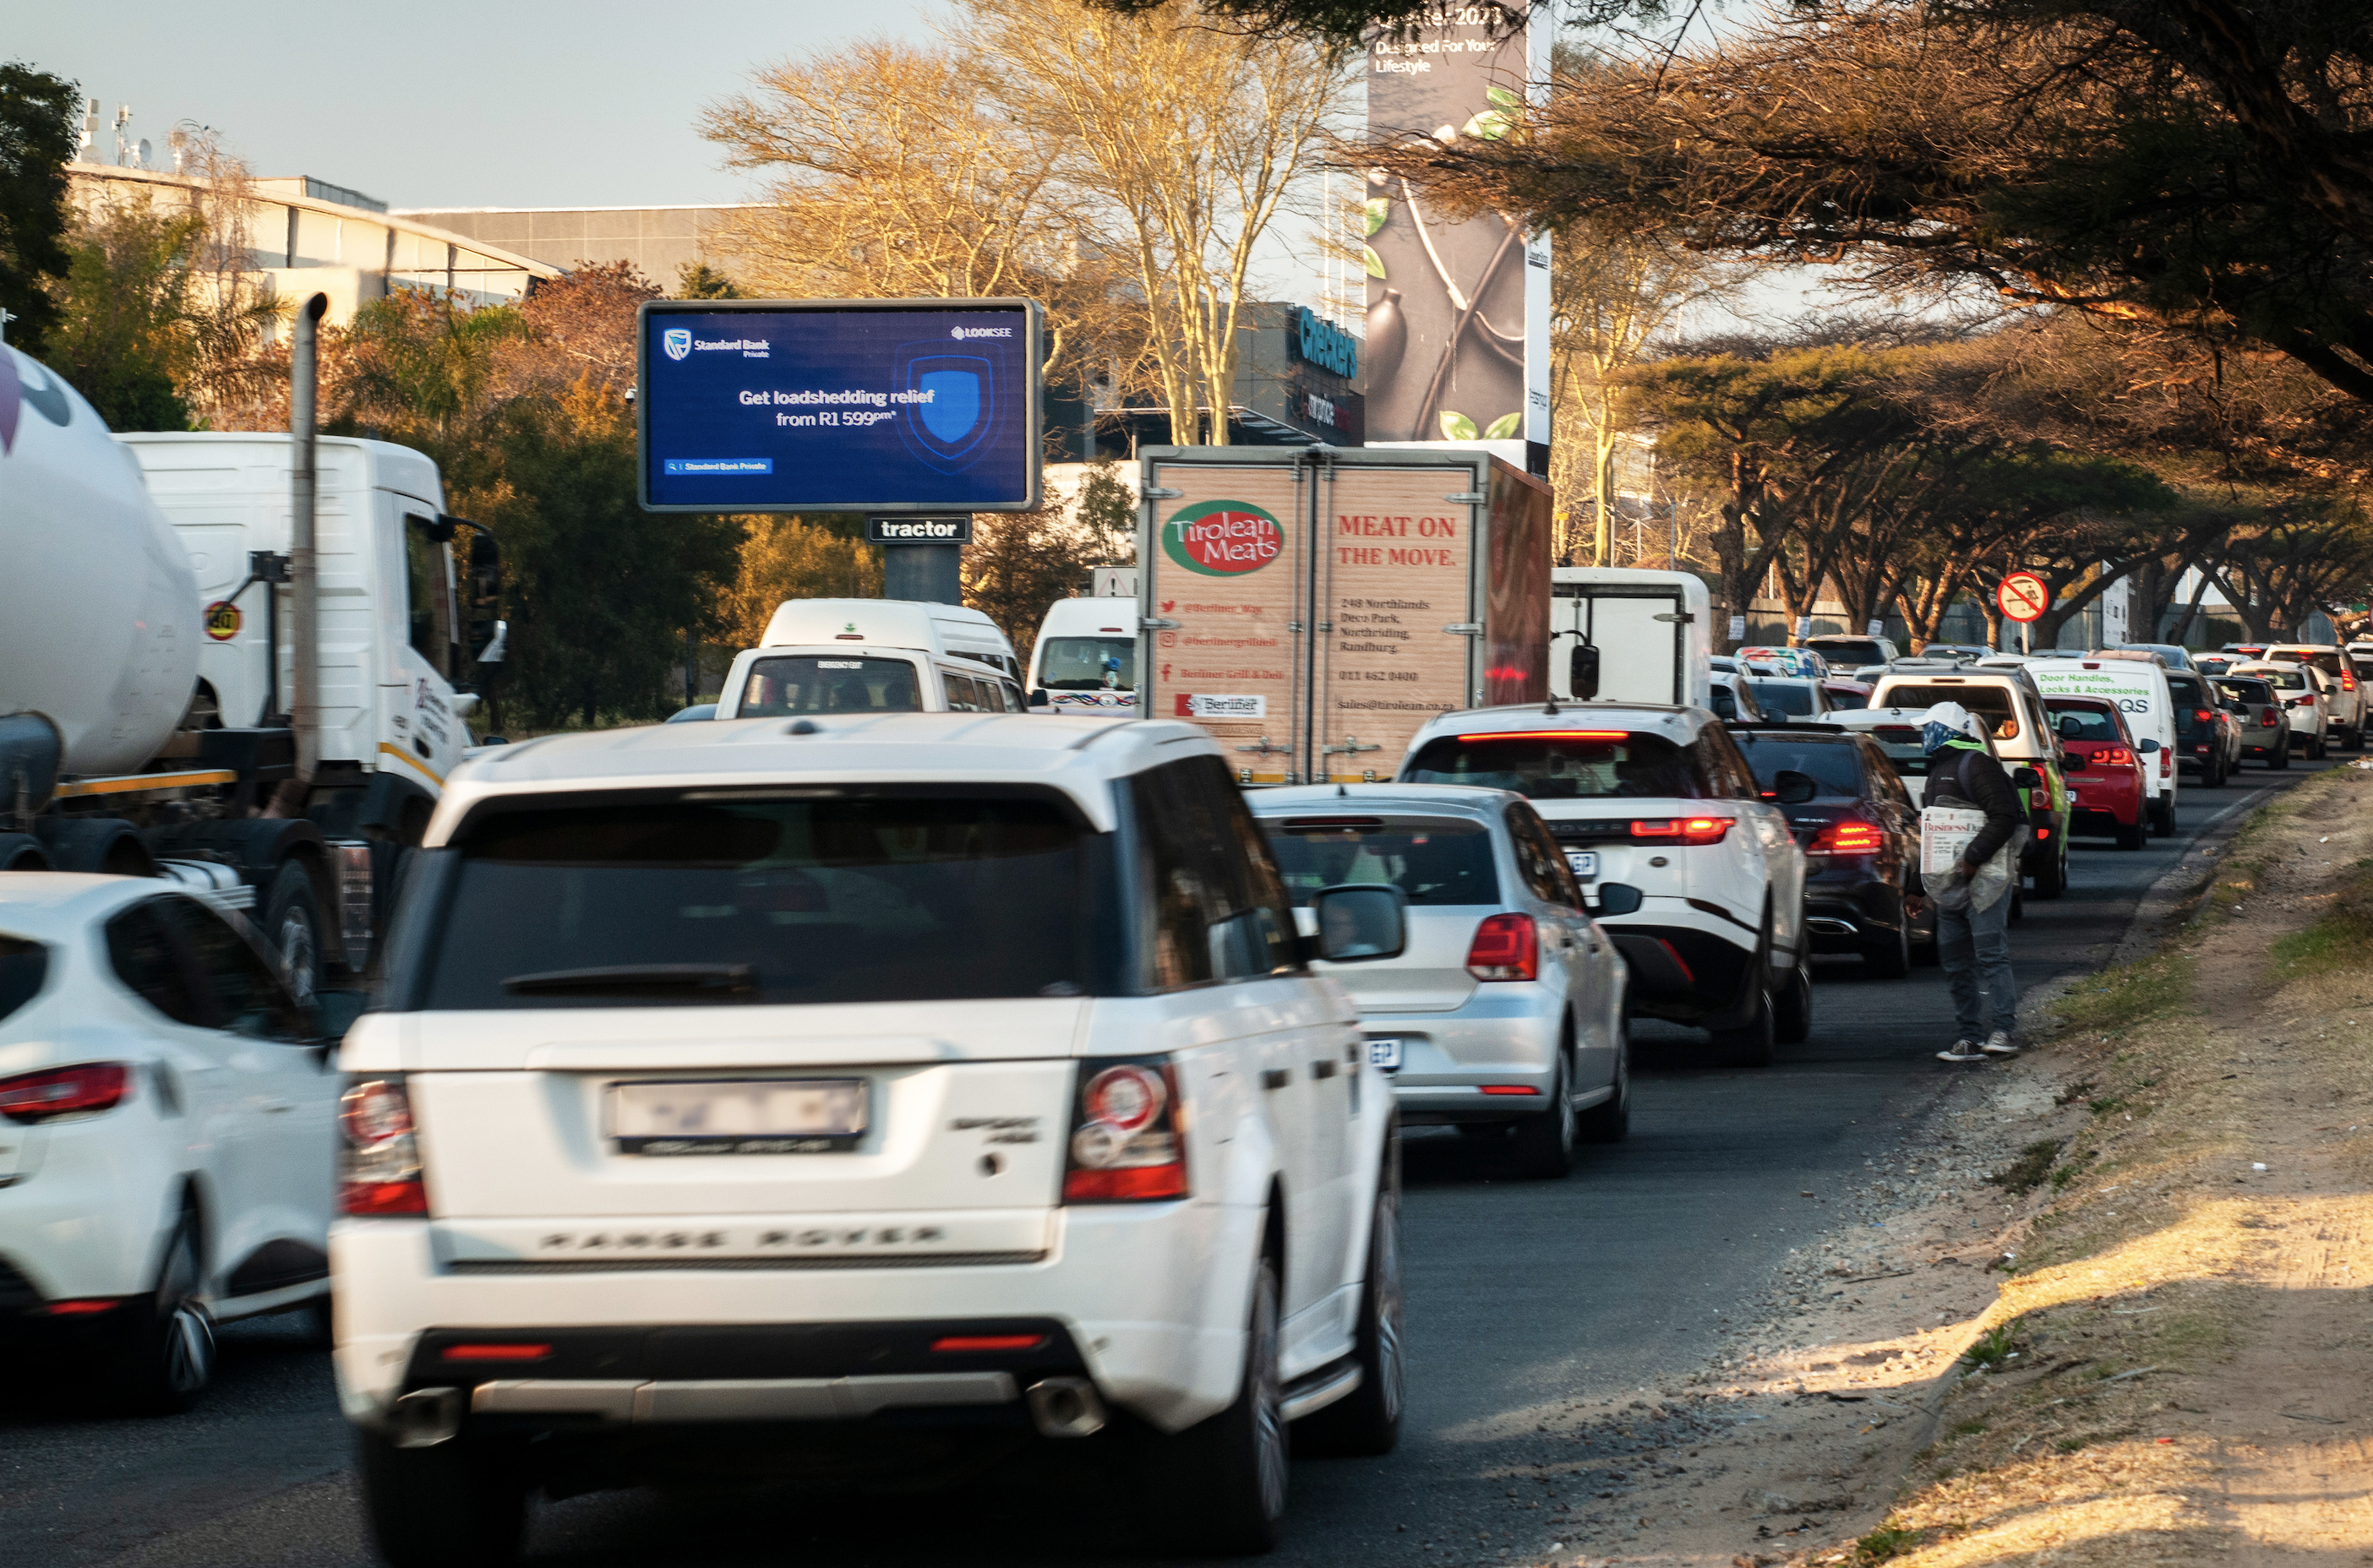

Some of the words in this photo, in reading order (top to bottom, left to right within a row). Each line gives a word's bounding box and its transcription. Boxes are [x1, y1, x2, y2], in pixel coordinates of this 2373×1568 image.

[1376, 40, 1439, 57] Designed
[1442, 40, 1464, 52] For
[1465, 39, 1496, 52] Your
[1376, 58, 1431, 75] Lifestyle
[964, 328, 1012, 337] LOOKSEE
[694, 340, 742, 351] Standard
[742, 340, 770, 350] Bank
[1300, 306, 1357, 379] Checkers
[739, 390, 771, 405] Get
[773, 389, 887, 407] loadshedding
[890, 389, 935, 403] relief
[776, 412, 816, 426] from
[819, 412, 840, 426] R1
[720, 462, 739, 471] Bank
[739, 462, 767, 471] Private
[881, 520, 957, 536] tractor
[1170, 511, 1274, 542] Tirolean
[1338, 515, 1413, 536] MEAT
[1418, 516, 1456, 537] ON
[1203, 536, 1279, 564] Meats
[1337, 547, 1383, 564] THE
[1388, 548, 1457, 566] MOVE.
[1340, 598, 1362, 608] 248
[1365, 599, 1430, 609] Northlands
[1340, 612, 1368, 622] Deco
[1180, 669, 1225, 678] Berliner
[1339, 671, 1361, 680] 011
[1364, 671, 1386, 681] 462
[1388, 672, 1419, 682] 0400
[2068, 674, 2114, 683] Handles,
[2039, 685, 2070, 694] Locks
[2084, 686, 2150, 695] Accessories
[1203, 697, 1258, 710] Berliner
[2119, 699, 2148, 713] QS
